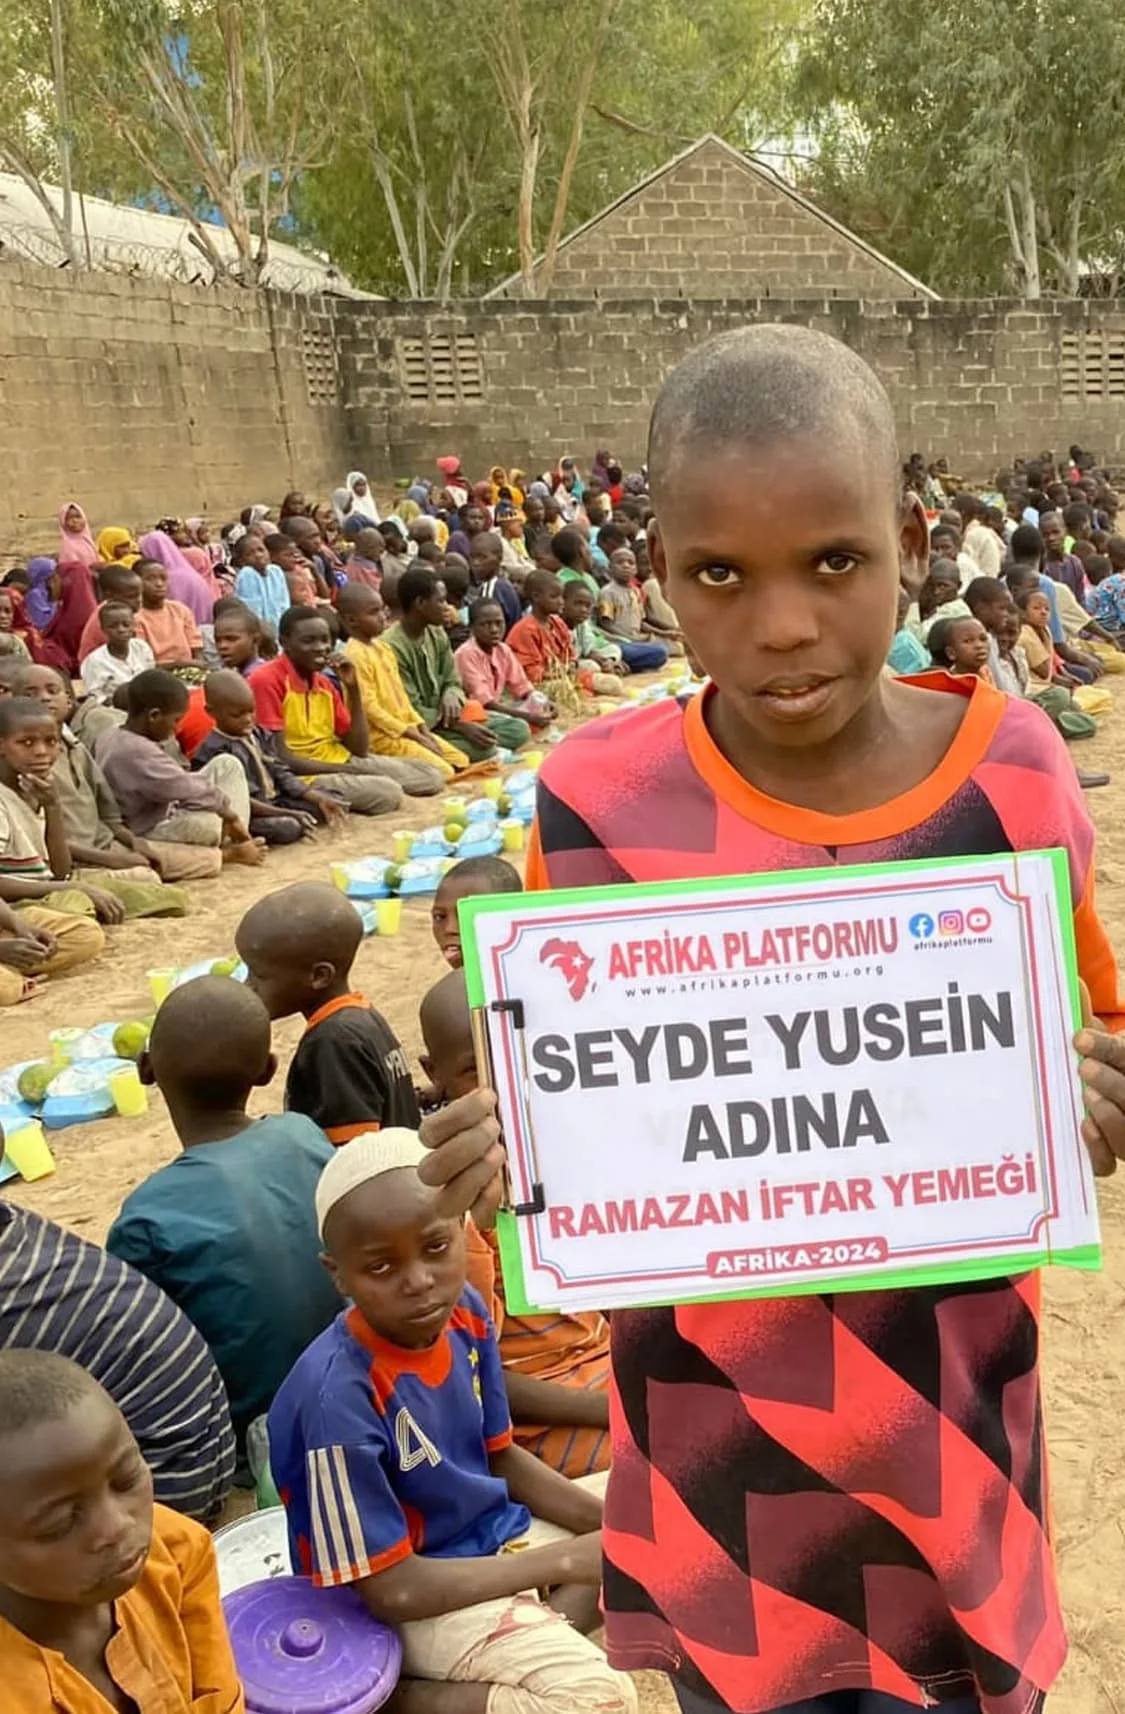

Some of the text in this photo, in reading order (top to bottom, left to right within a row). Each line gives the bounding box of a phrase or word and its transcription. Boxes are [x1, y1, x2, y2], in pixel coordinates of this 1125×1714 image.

[608, 917, 898, 979] AFRİKA PLATFORMU
[914, 937, 992, 951] afrikaplatformu
[625, 965, 885, 998] www.afrikaplatformu.org
[532, 982, 1016, 1093] SEYDE YUSEİN
[682, 1089, 890, 1162] ADINA
[548, 1153, 1038, 1240] RAMAZAN İFTAR YEMEĞİ
[715, 1242, 882, 1276] AFRİKA-2024
